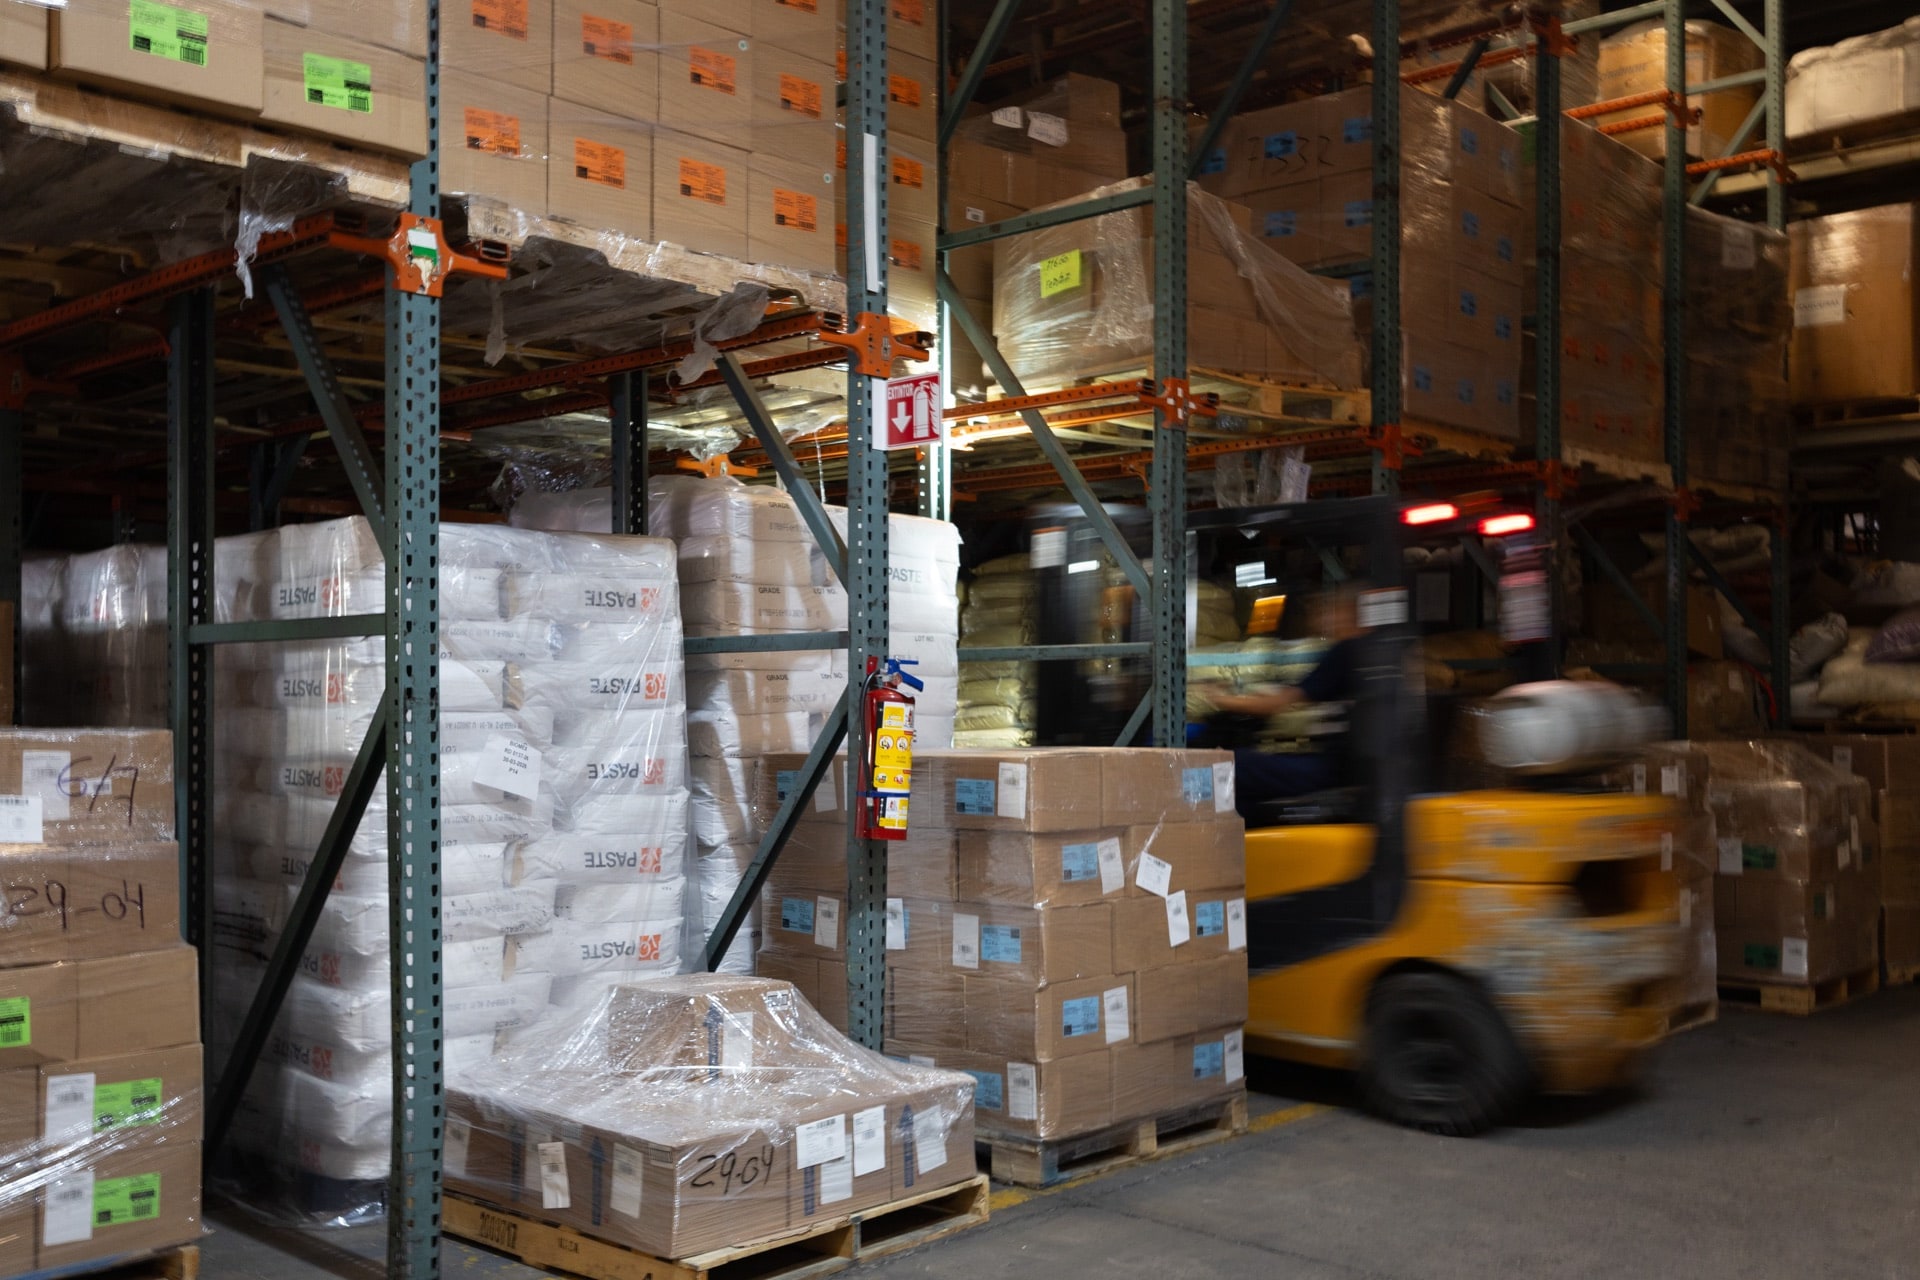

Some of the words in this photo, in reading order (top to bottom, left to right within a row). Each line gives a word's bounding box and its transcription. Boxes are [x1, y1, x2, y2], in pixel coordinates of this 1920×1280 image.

[887, 382, 914, 401] EXTINTOR
[887, 567, 922, 583] PASTE
[278, 585, 317, 607] PASTE
[583, 590, 637, 608] PASTE
[758, 586, 781, 595] GRADE
[282, 679, 322, 697] PASTE
[589, 677, 641, 694] PASTE
[283, 768, 321, 788] PASTE
[508, 767, 519, 775] P14
[586, 762, 640, 780] PASTE
[281, 856, 311, 877] ASTE
[583, 851, 637, 868] PASTE
[580, 940, 636, 960] PASTE
